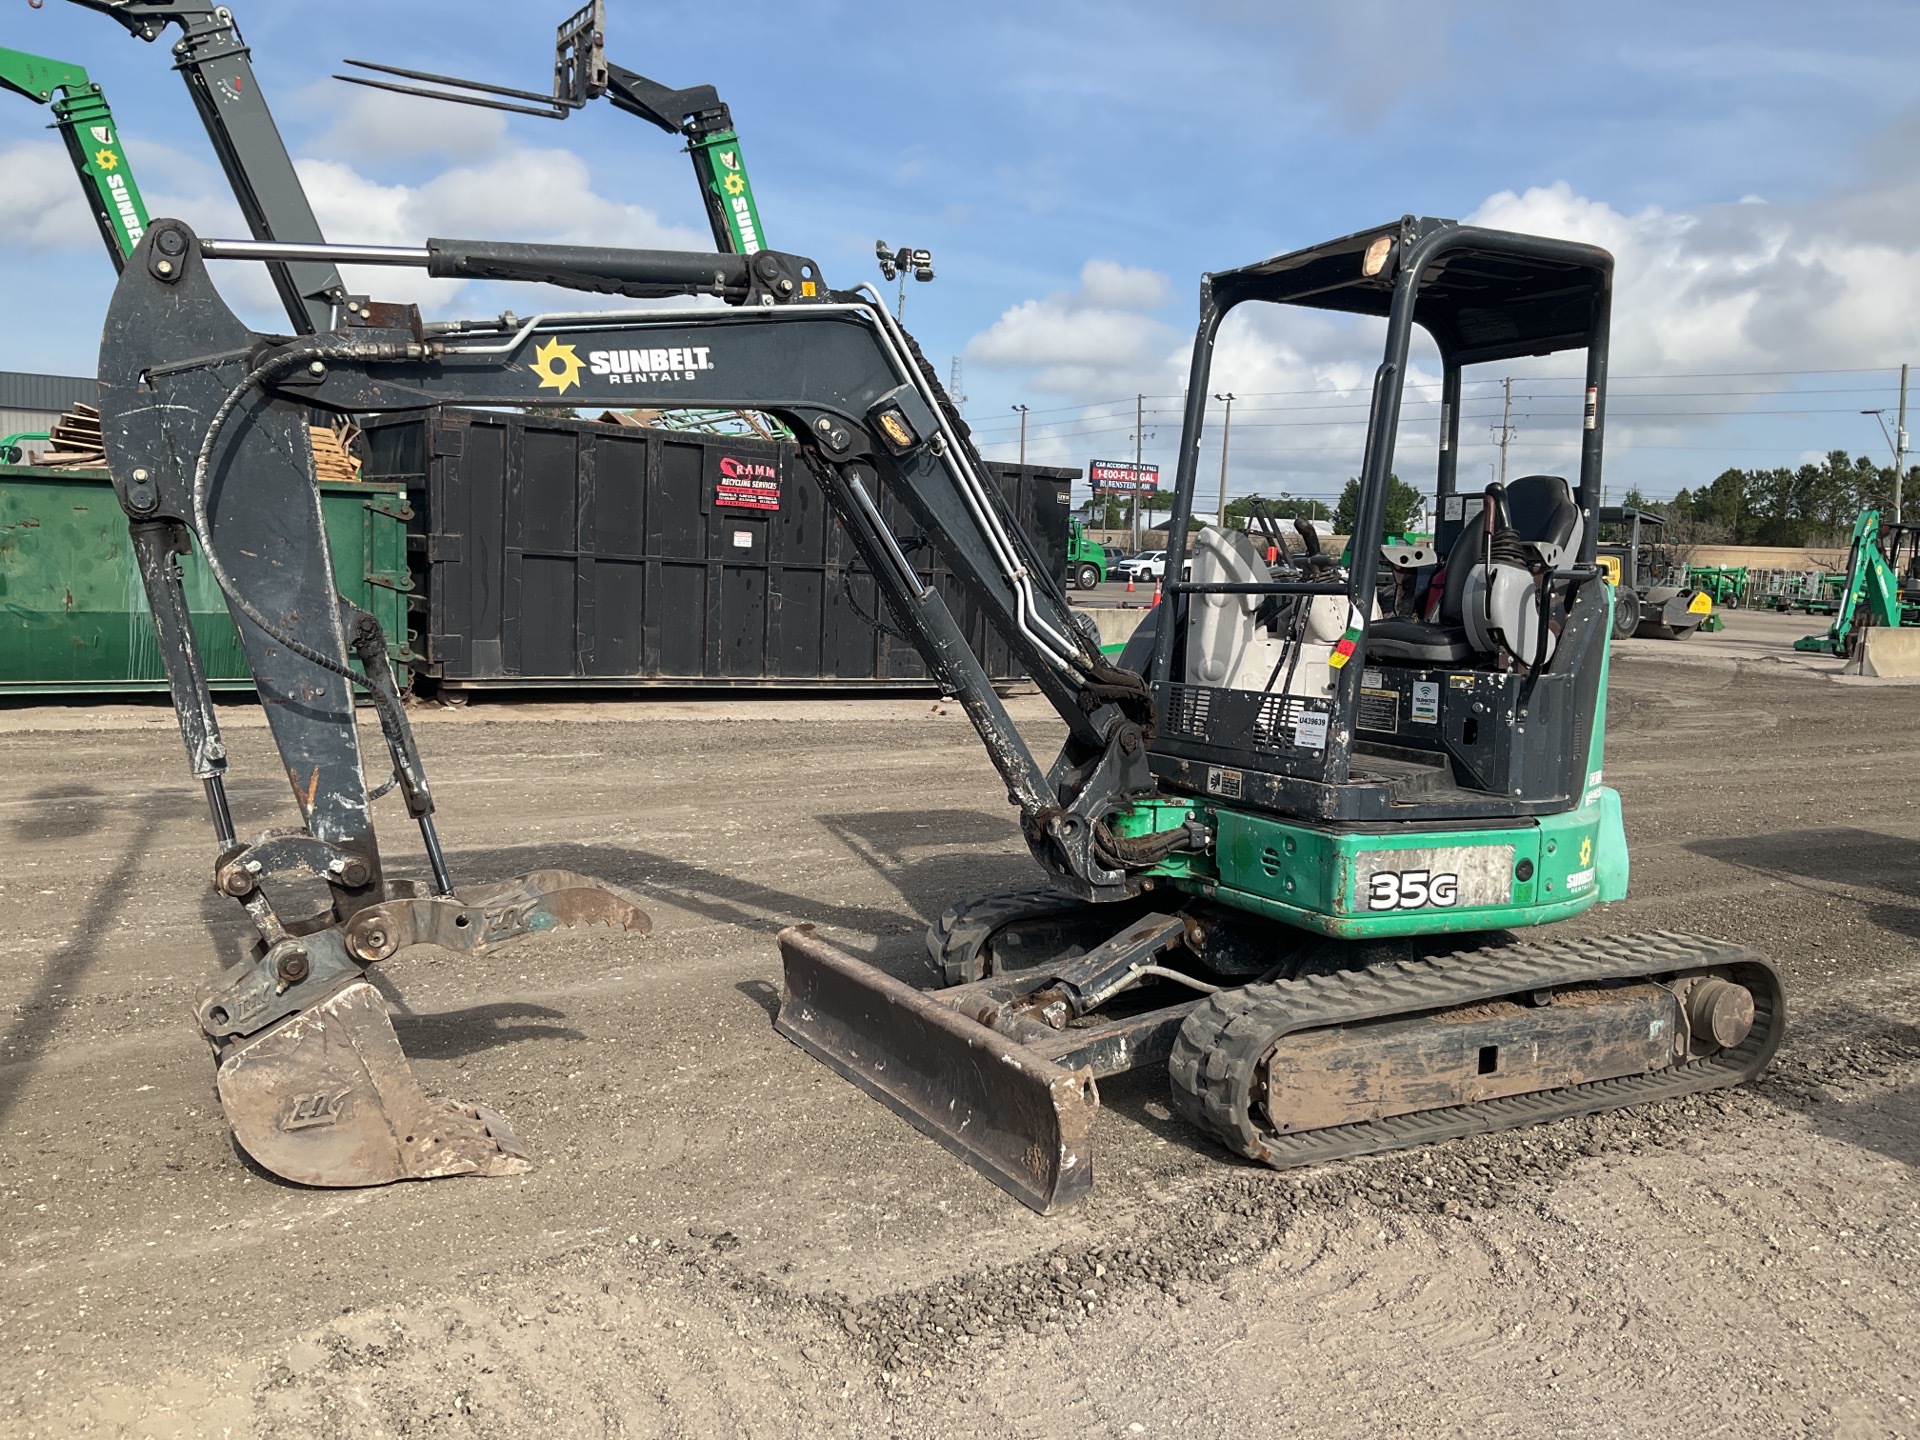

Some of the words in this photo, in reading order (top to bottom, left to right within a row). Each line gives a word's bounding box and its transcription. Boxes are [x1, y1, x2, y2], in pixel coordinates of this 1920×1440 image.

[588, 347, 711, 375] SUNBELT
[609, 370, 696, 384] RENTALS
[736, 464, 776, 478] RAMM
[721, 478, 751, 488] RECYCLING
[751, 481, 778, 489] SERVICES
[1299, 716, 1326, 726] U439639
[1368, 869, 1458, 911] 35G
